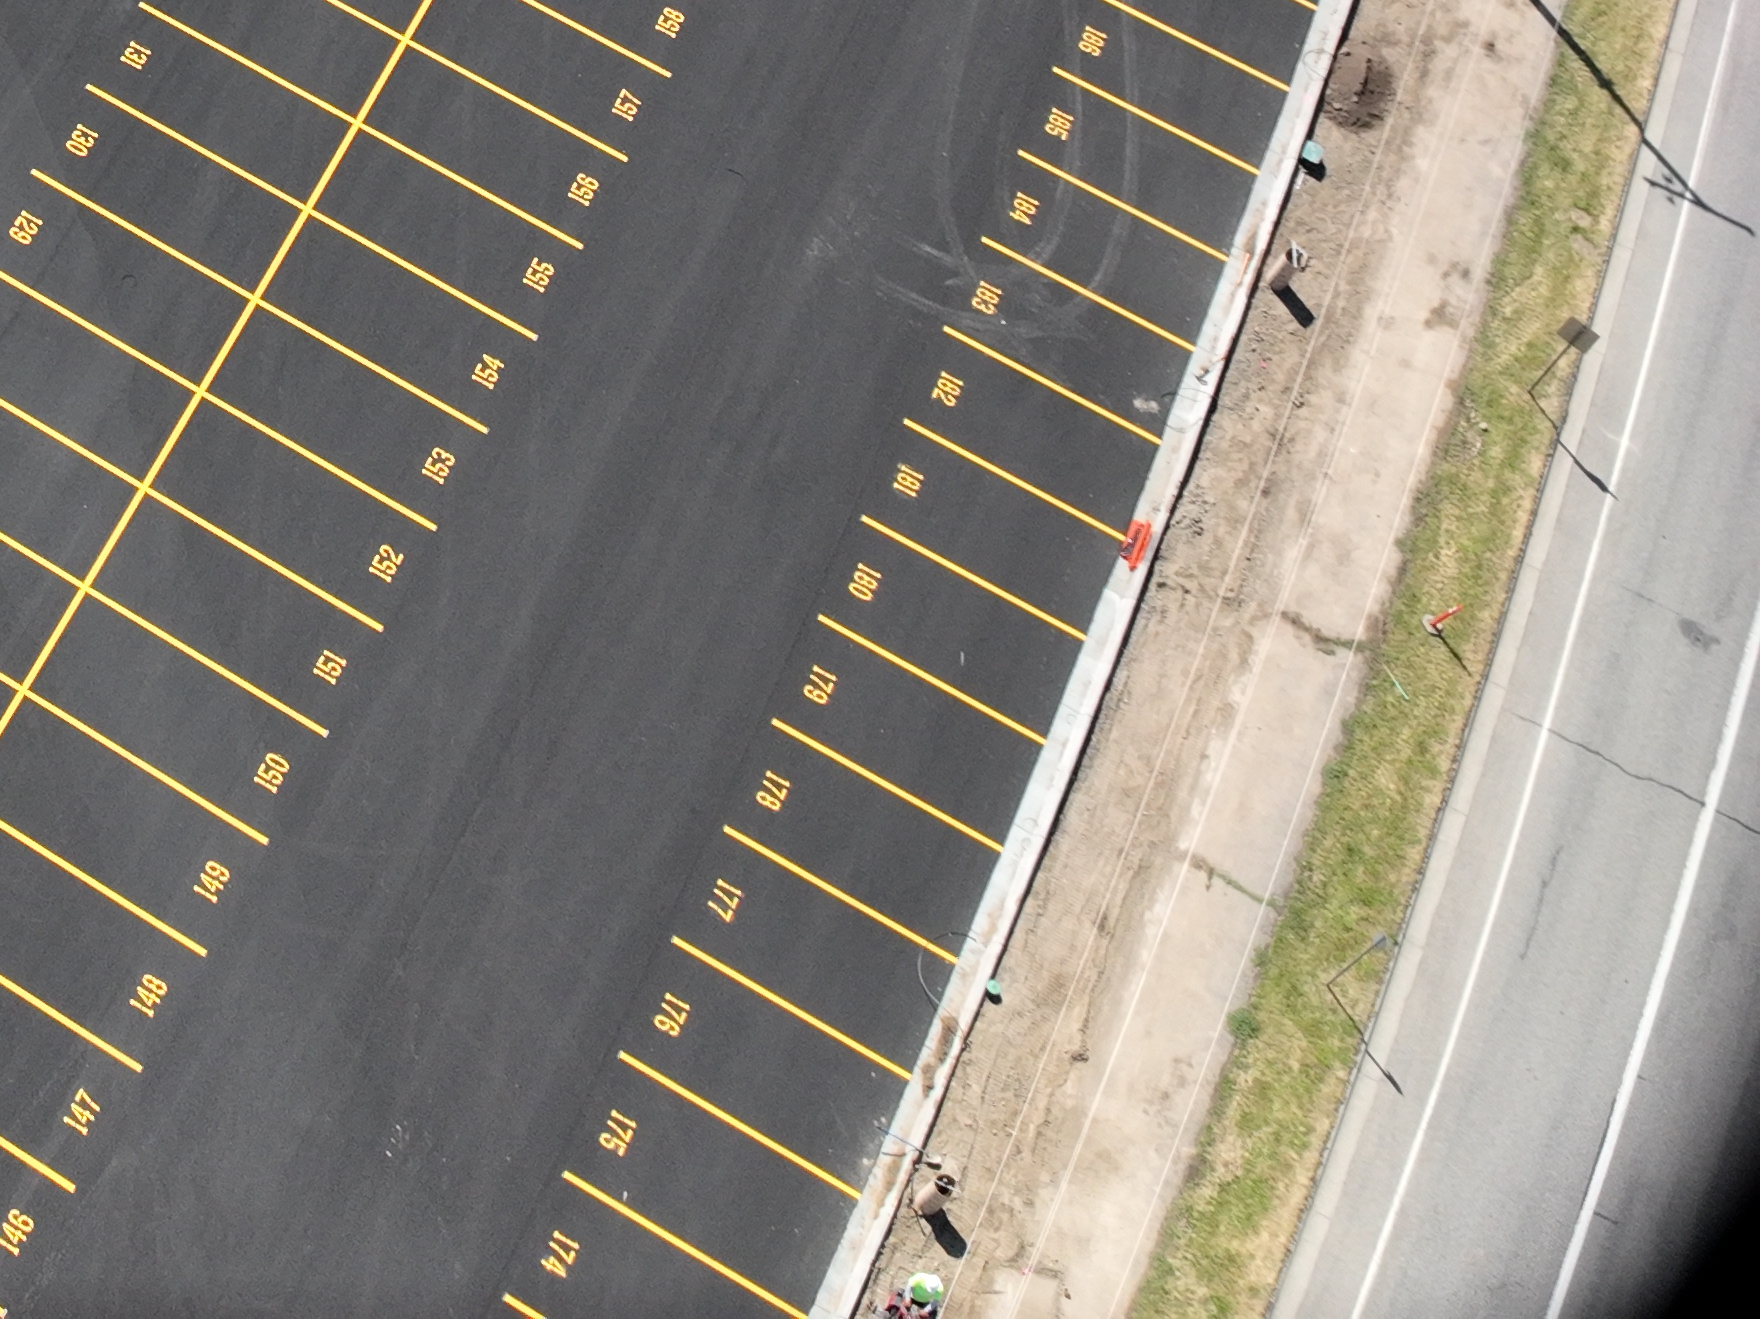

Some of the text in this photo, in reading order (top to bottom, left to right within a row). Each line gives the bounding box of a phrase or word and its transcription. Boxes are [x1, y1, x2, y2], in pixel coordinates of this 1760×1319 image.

[120, 41, 151, 70] 131
[1078, 26, 1108, 56] 186
[612, 89, 641, 121] 157
[9, 210, 43, 245] 129
[1009, 192, 1040, 225] 184
[472, 354, 504, 389] 154
[931, 371, 964, 406] 182
[369, 545, 404, 583] 152
[848, 563, 882, 601] 180
[254, 753, 289, 794] 150
[756, 770, 790, 811] 178
[129, 974, 168, 1018] 148
[653, 993, 690, 1037] 176
[63, 1088, 100, 1136] 147
[599, 1109, 637, 1157] 175
[541, 1230, 580, 1278] 174
